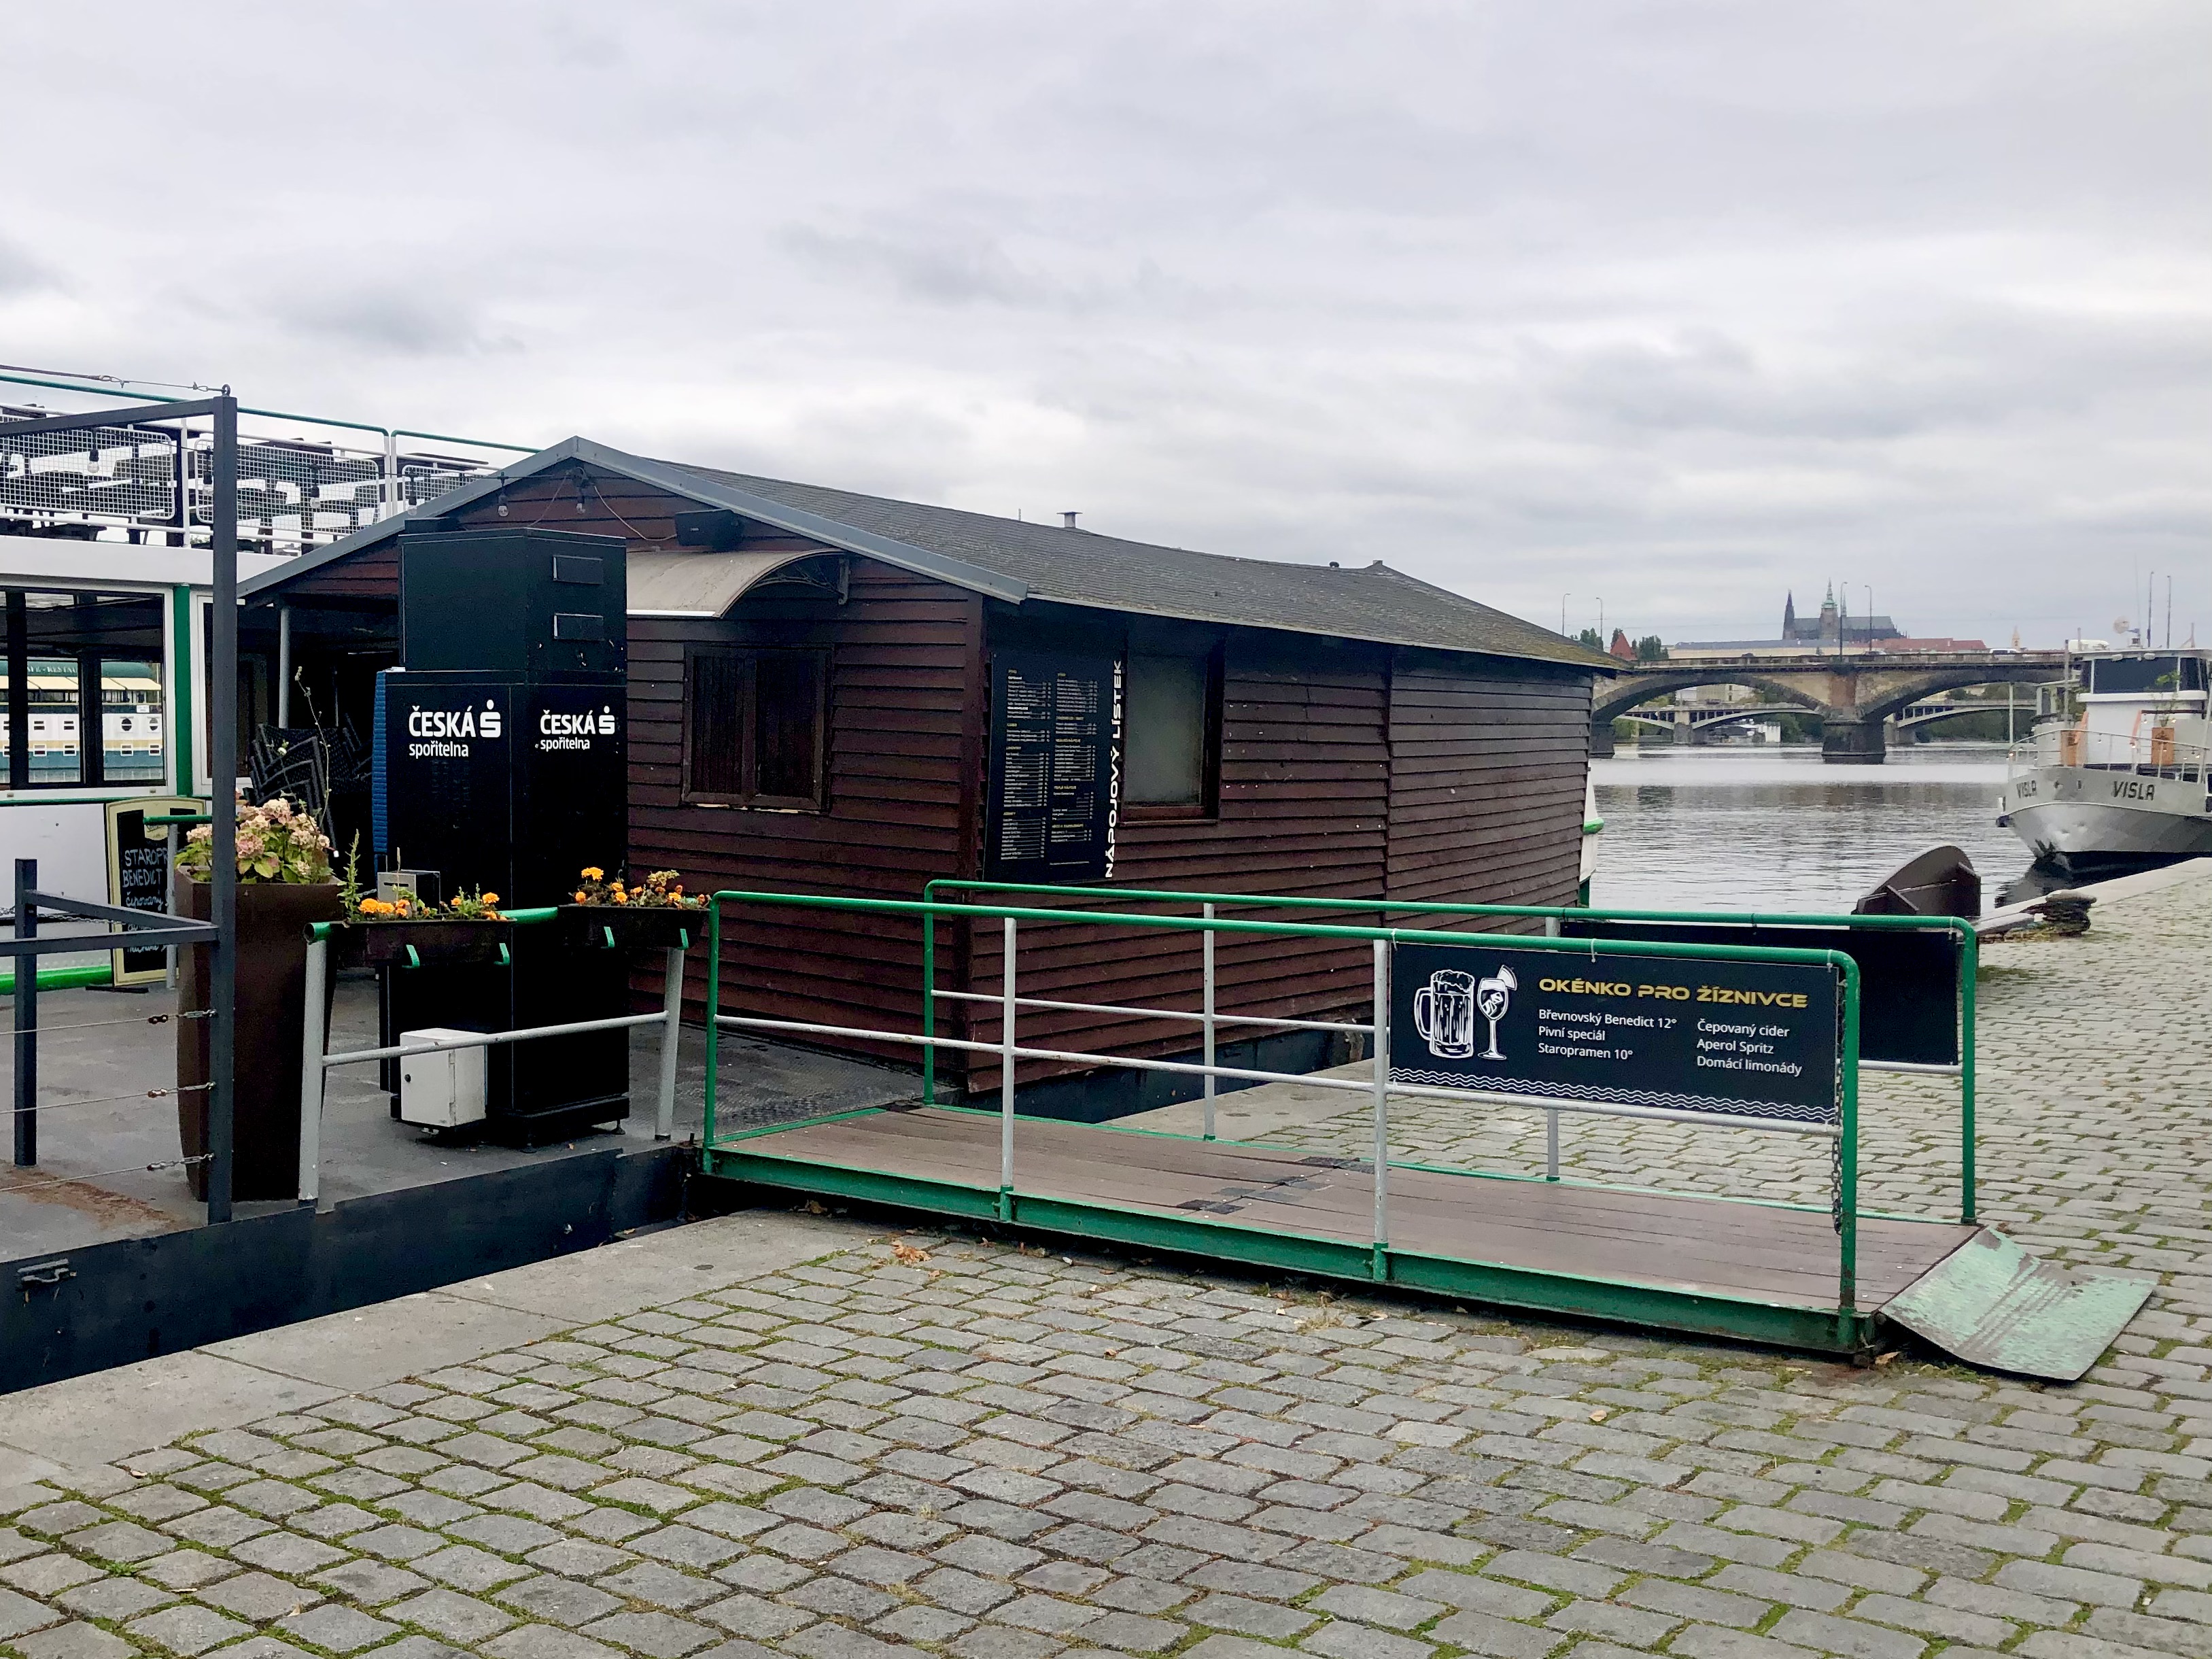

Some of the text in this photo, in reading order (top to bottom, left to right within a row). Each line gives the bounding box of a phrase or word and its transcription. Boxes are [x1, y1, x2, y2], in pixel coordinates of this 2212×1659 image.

[409, 706, 476, 737] ČESKÁ
[540, 710, 595, 734] ČESKÁ
[409, 740, 468, 759] spořitelna
[540, 737, 589, 751] spořitelna
[1106, 661, 1122, 877] NÁPOJOVÝ LÍSTEK
[2016, 780, 2037, 798] VISLA
[2112, 781, 2155, 801] VISLA
[124, 848, 168, 867] STAROPR
[122, 869, 162, 887] BENEDICT
[1540, 978, 1808, 1008] OKÉNKO PRO ŽÍZNIVCE
[1539, 1009, 1677, 1028] Břevnovský Benedict 12°
[1697, 1019, 1790, 1037] Čepovaný cider
[1539, 1026, 1605, 1041] Pivní speciál
[1538, 1043, 1633, 1059] Staropramen 10°
[1697, 1039, 1774, 1055] Aperol Spritz
[1697, 1056, 1802, 1076] Domácí limonády
